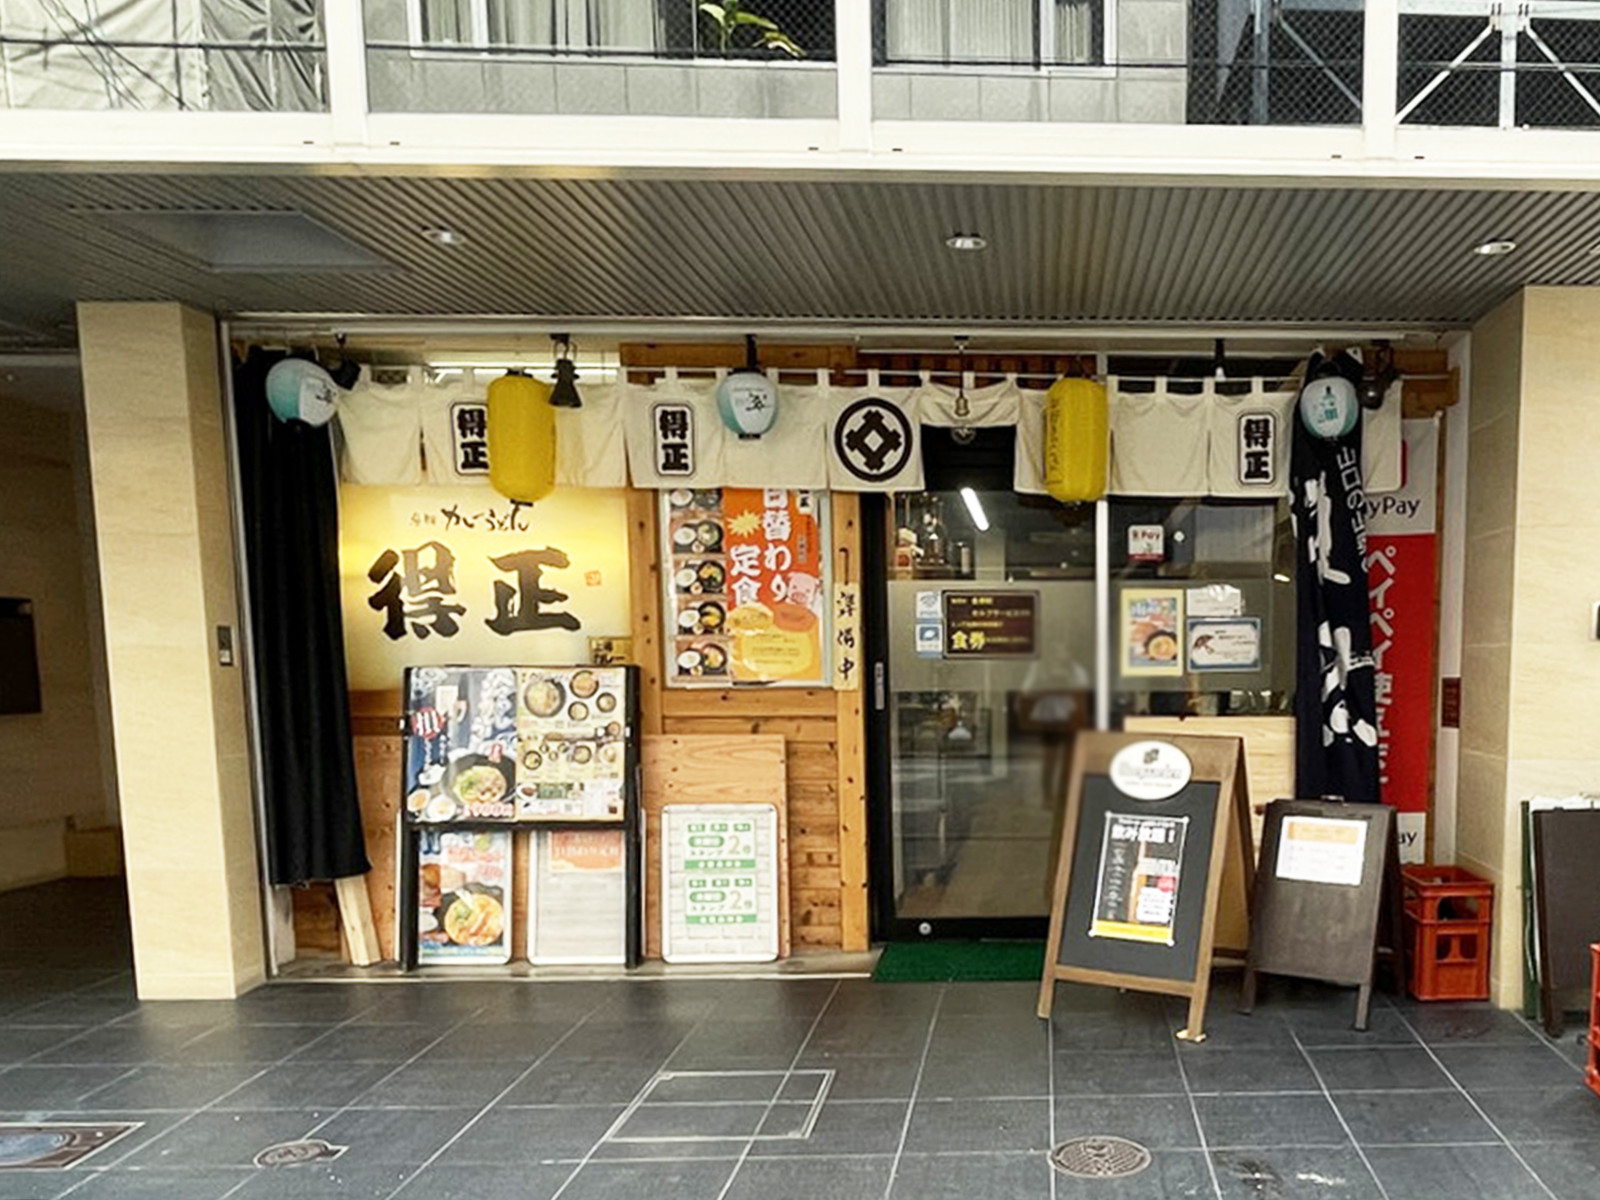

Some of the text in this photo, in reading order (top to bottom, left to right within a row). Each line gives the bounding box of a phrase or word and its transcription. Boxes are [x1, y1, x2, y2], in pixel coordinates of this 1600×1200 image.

[457, 409, 488, 470] 得正
[659, 410, 690, 472] 得正
[1243, 418, 1271, 479] 得正
[367, 540, 582, 642] 得正
[730, 545, 761, 605] 定食
